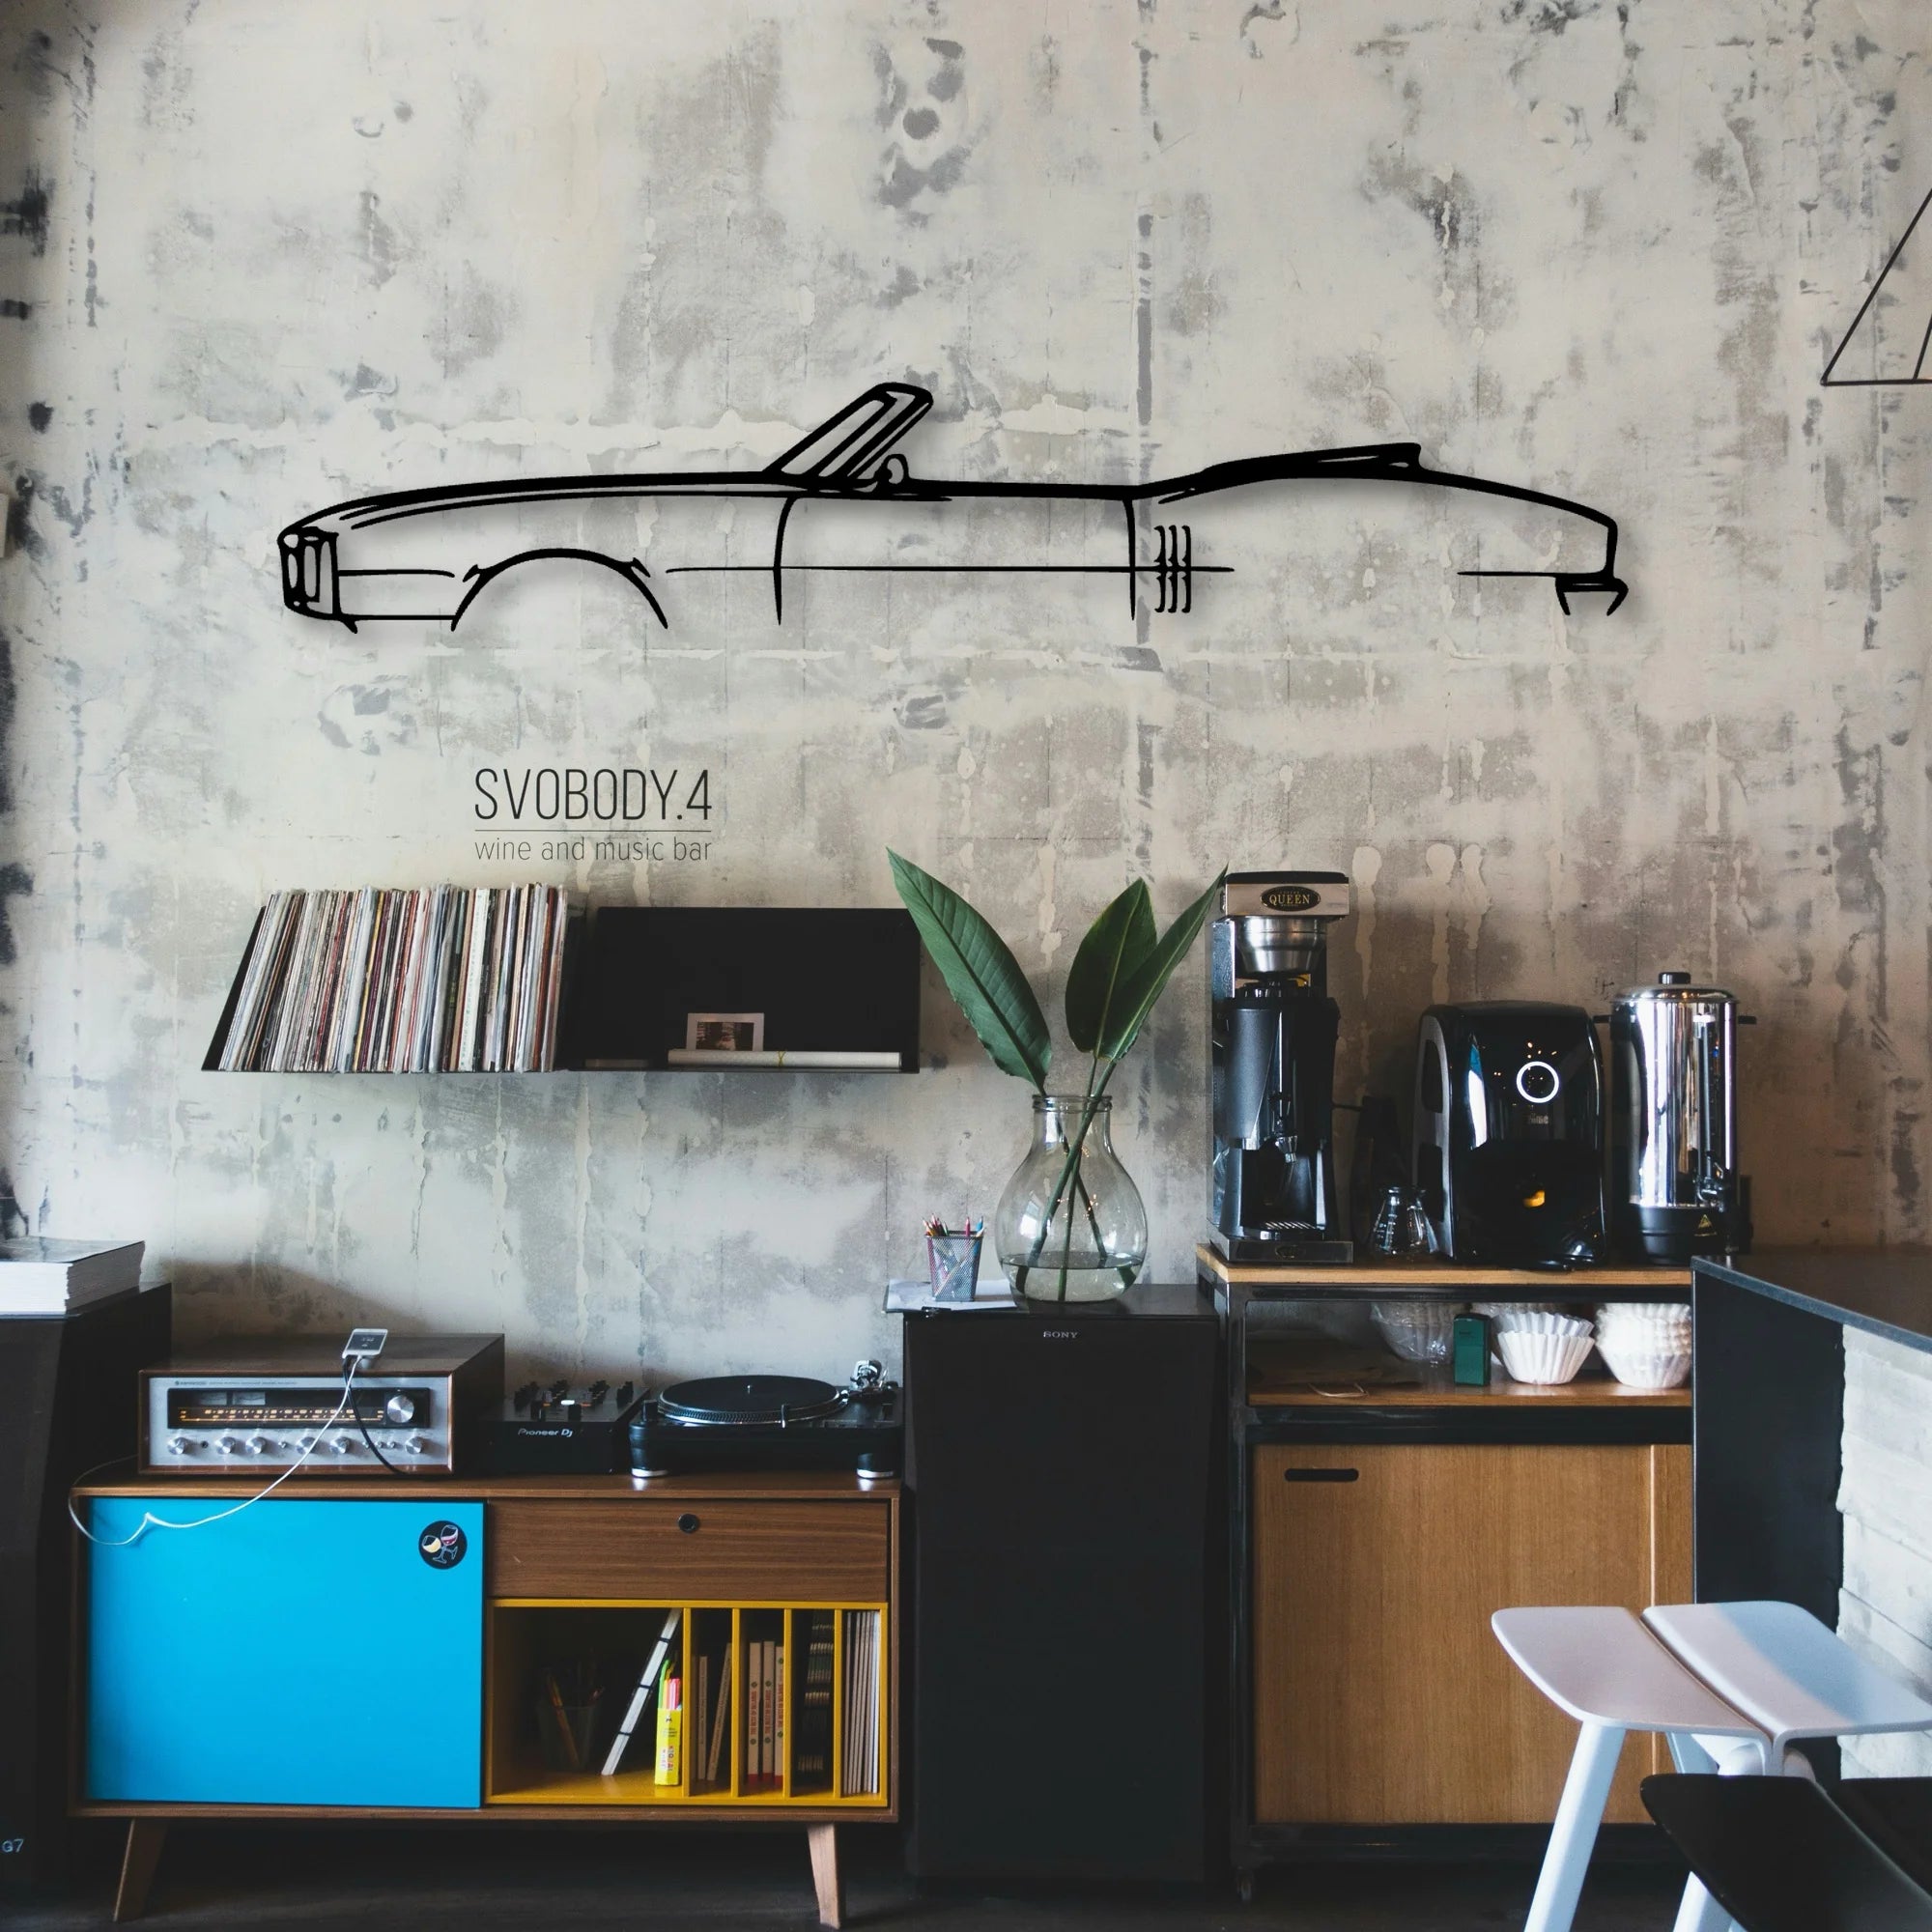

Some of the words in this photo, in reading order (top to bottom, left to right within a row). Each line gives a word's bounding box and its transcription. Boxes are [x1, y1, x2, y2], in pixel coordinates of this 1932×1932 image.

[475, 768, 712, 820] SVOBODY.4
[475, 838, 531, 861] wine
[542, 837, 585, 861] and
[596, 838, 664, 861] music
[673, 837, 712, 861] bar
[1269, 895, 1310, 905] QUEEN
[2, 1838, 24, 1853] G7
